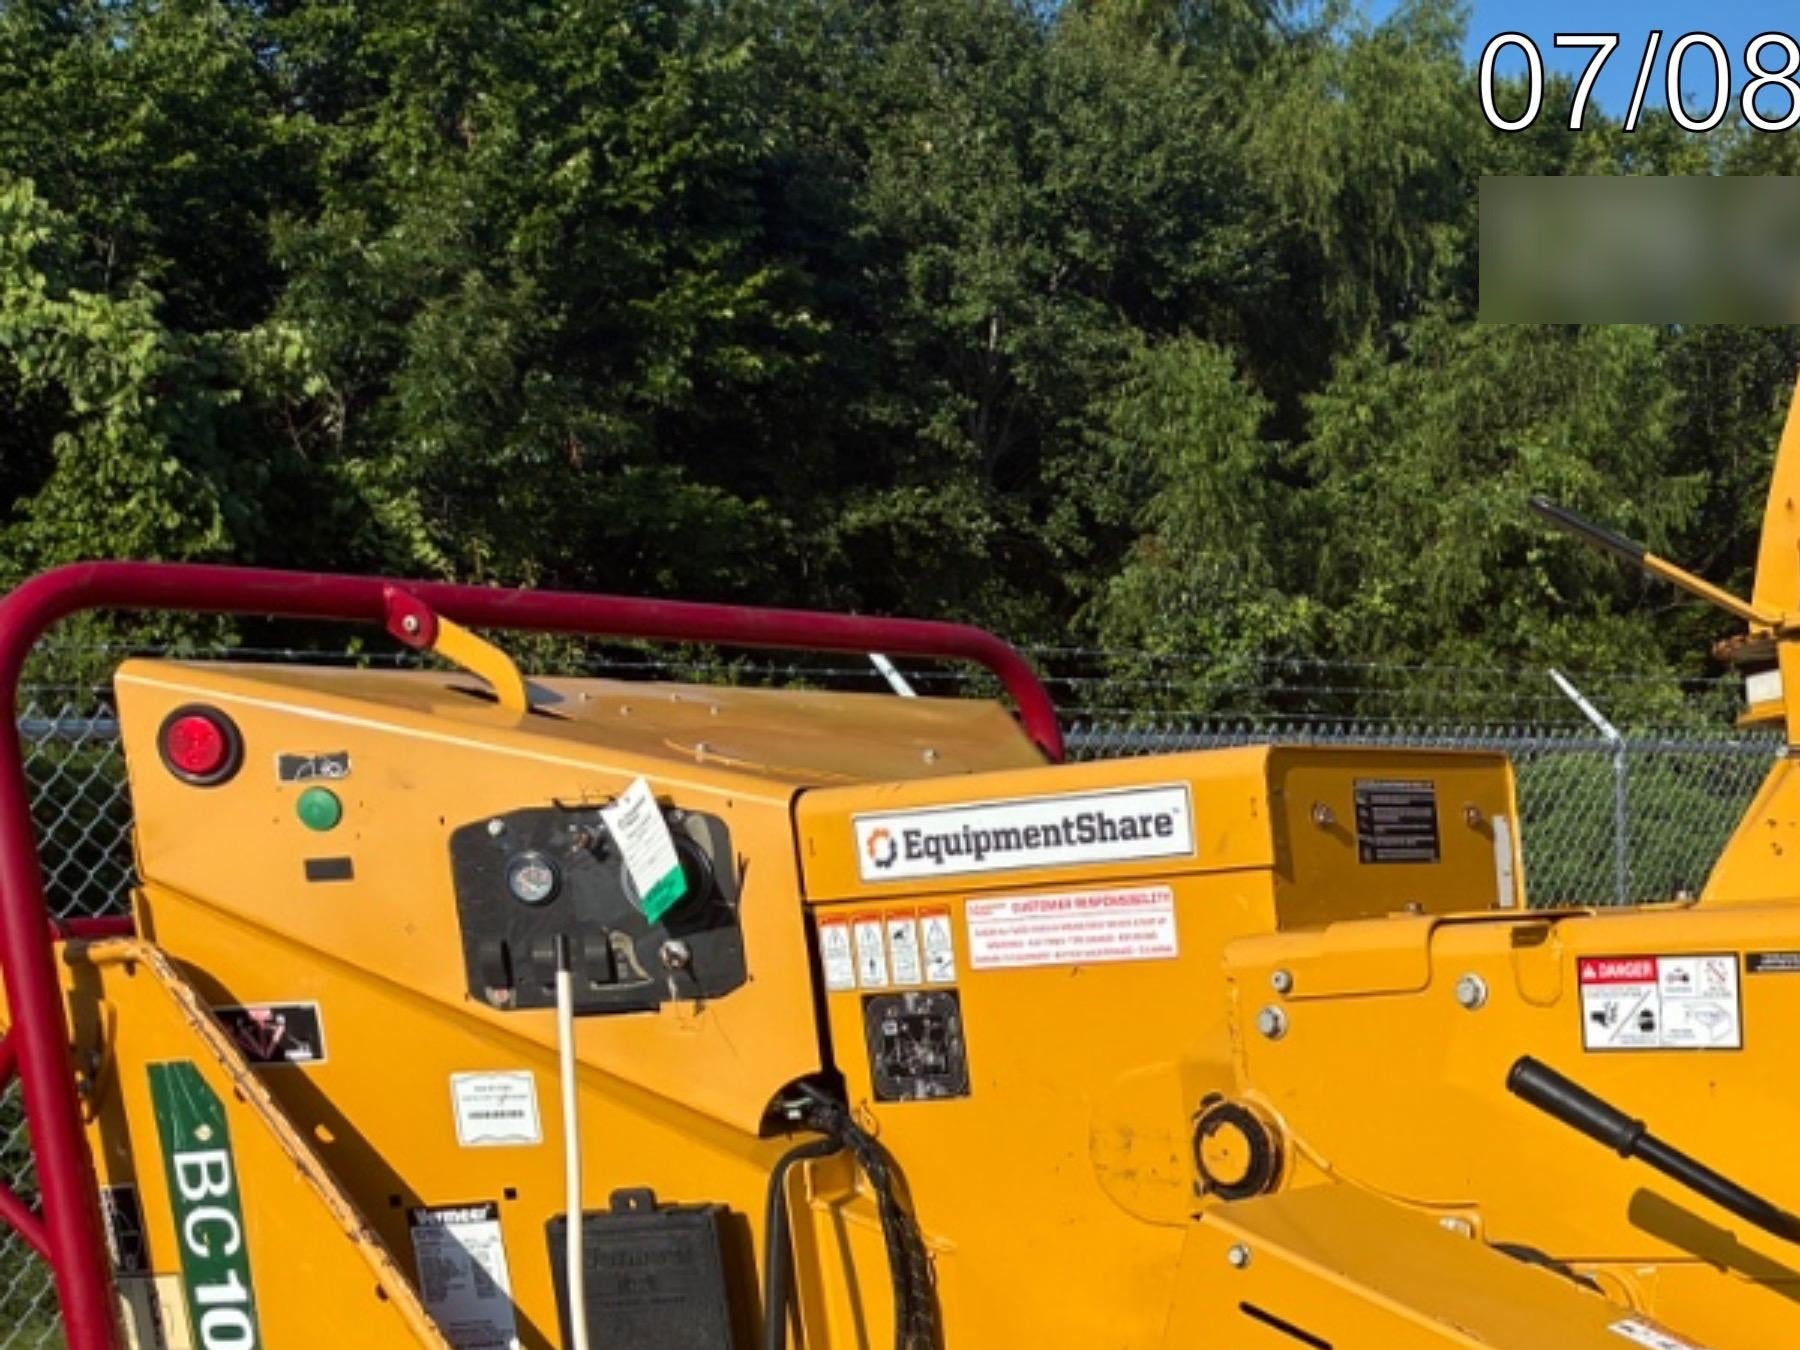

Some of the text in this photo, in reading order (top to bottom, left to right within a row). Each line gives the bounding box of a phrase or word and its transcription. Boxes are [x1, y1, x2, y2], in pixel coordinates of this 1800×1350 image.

[902, 811, 1175, 865] EquipmentShare
[1599, 960, 1653, 979] DANGER
[173, 1148, 242, 1259] BC
